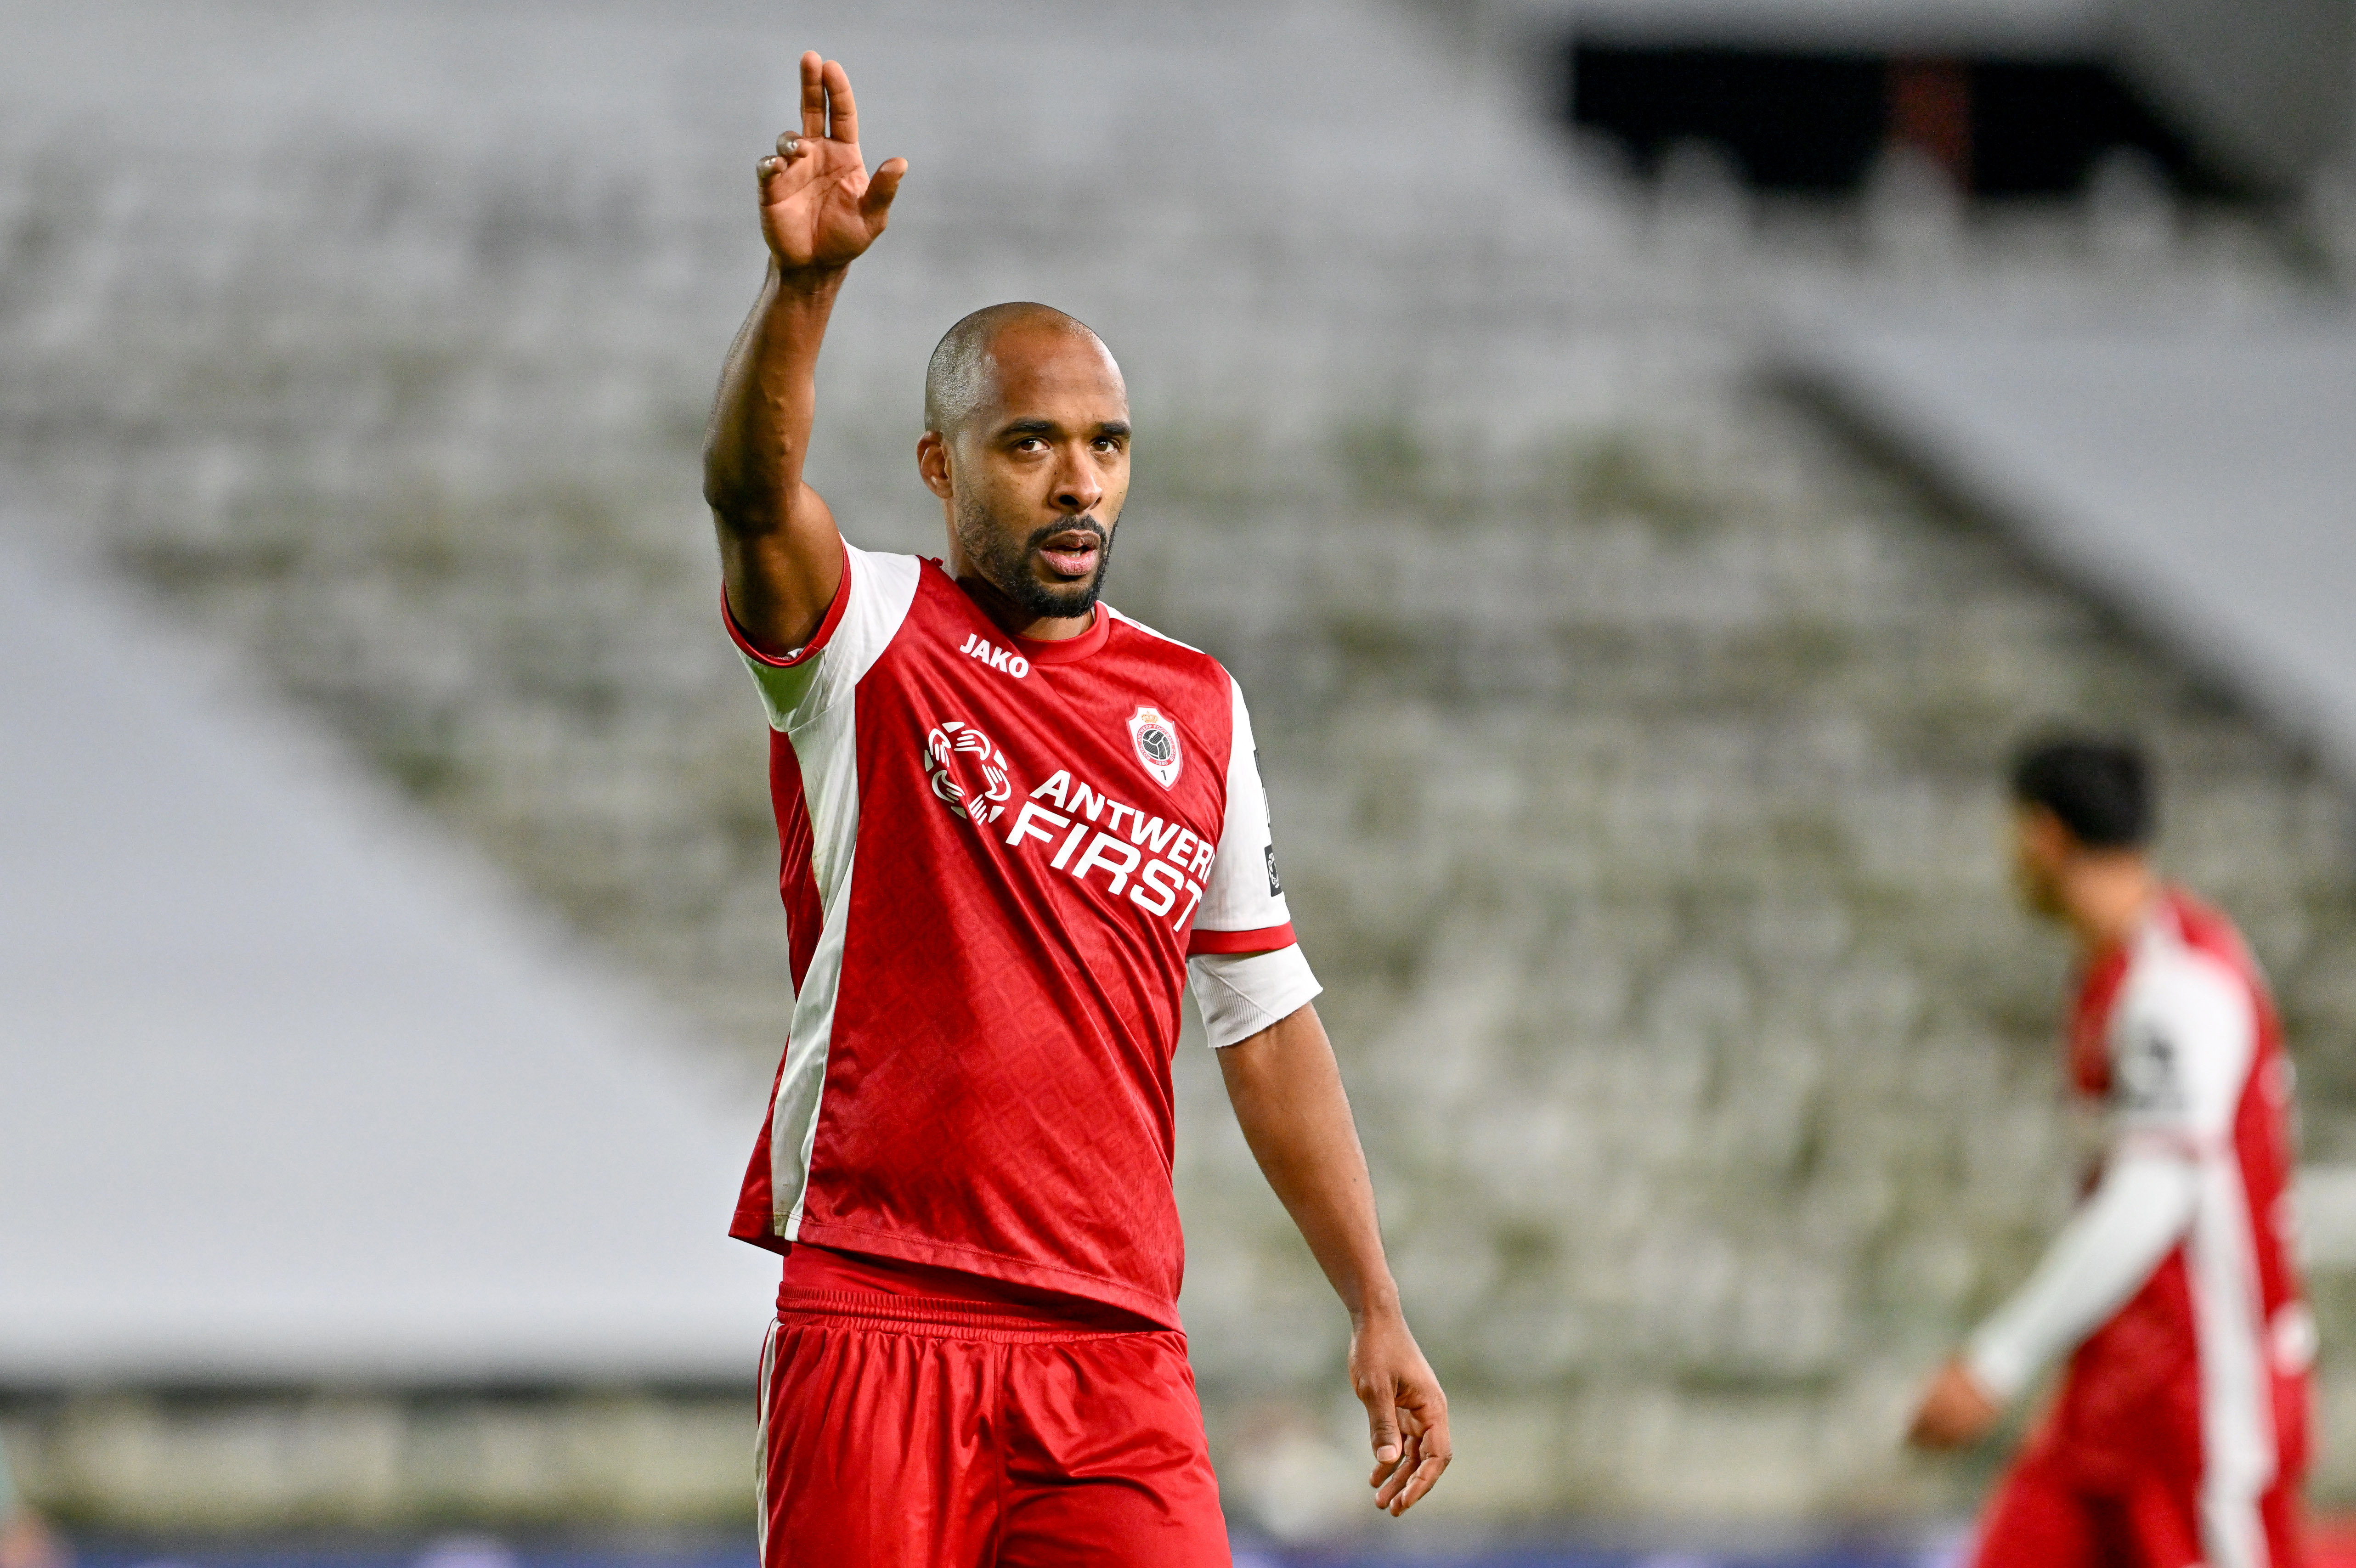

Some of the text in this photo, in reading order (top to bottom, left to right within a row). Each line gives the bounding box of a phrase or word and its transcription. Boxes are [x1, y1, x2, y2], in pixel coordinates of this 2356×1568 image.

[959, 633, 1029, 678] JAKO
[1137, 724, 1153, 742] ANTWERP
[1153, 725, 1174, 747] FOOTBALL
[1139, 744, 1151, 760] ROYAL
[1161, 770, 1167, 781] 1
[1006, 801, 1203, 932] FIRST
